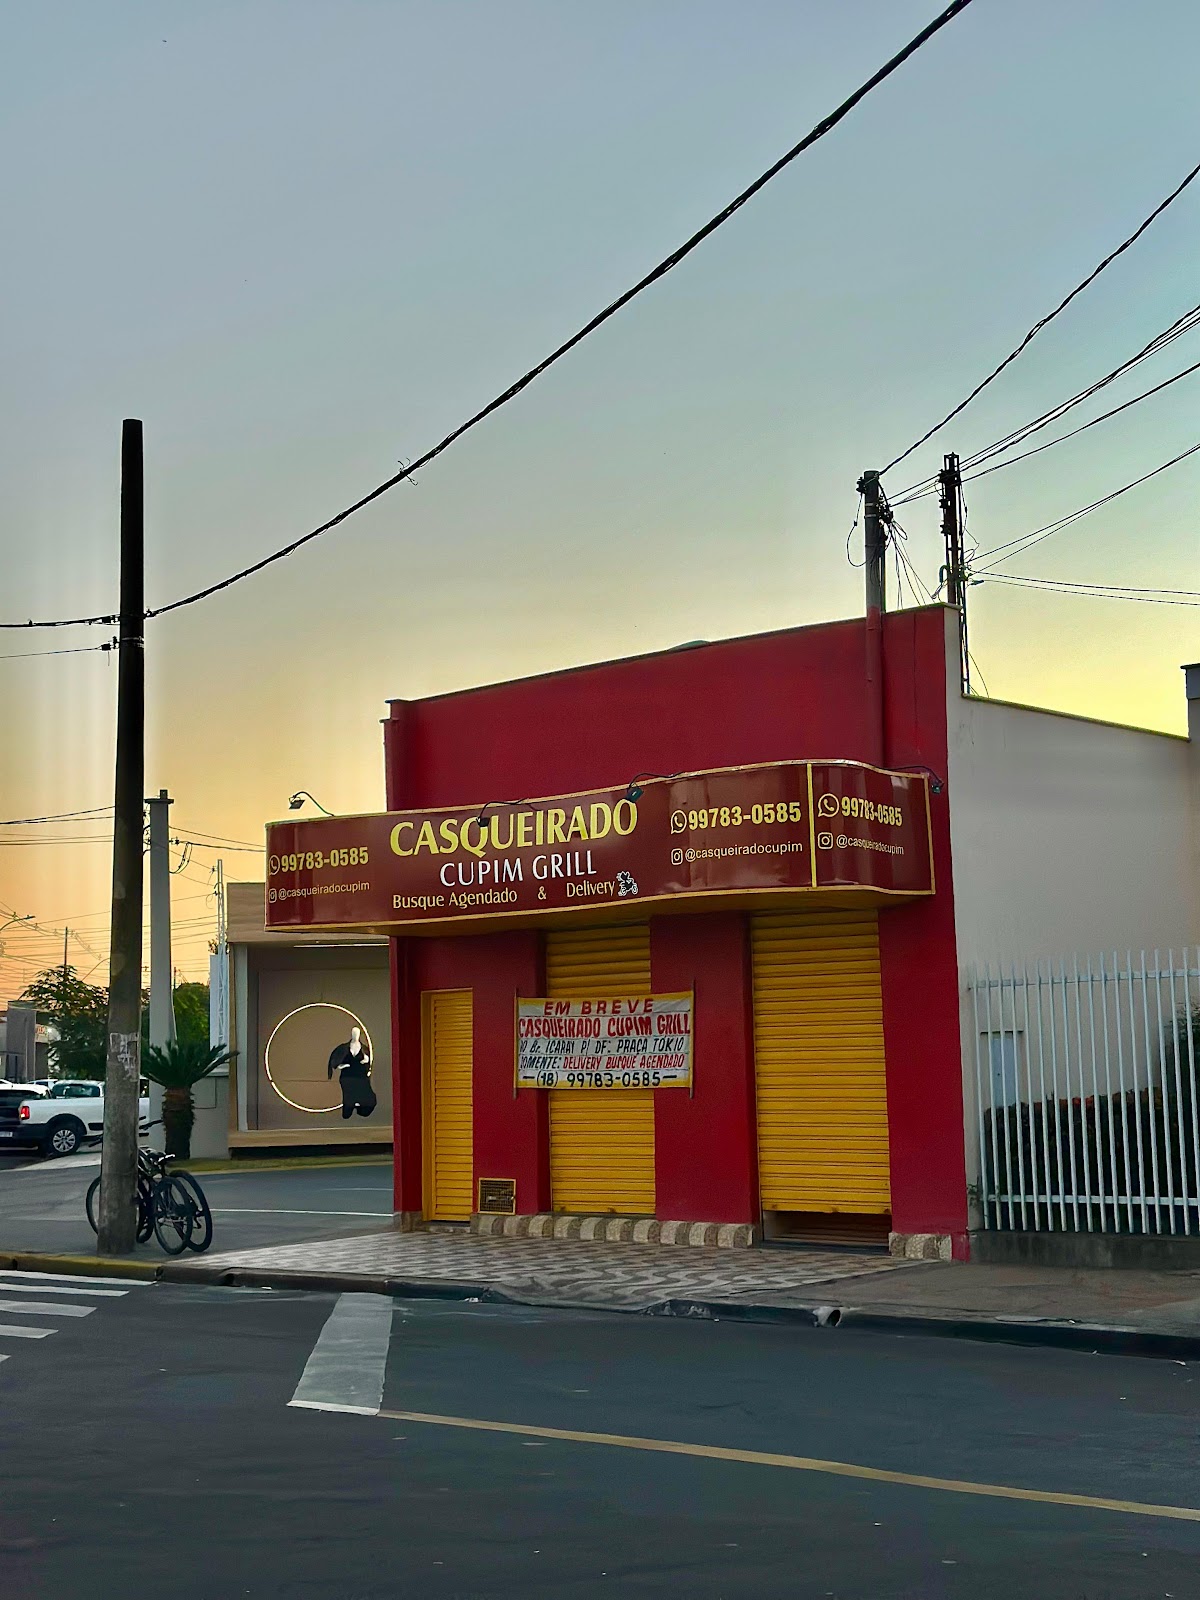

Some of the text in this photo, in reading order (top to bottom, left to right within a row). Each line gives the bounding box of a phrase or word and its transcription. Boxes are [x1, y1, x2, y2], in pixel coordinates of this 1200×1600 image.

[688, 802, 801, 830] 99783-0585
[841, 796, 903, 827] 99783-0585
[390, 798, 638, 858] CASQUEIRADO
[281, 847, 369, 872] 99783-0585
[685, 841, 803, 862] @casqueiradocupim
[440, 850, 597, 887] CUPIM GRILL
[278, 881, 370, 900] @casqueiradocupim
[393, 880, 615, 910] Busque Agendado & Delivery
[544, 998, 654, 1016] EM BREVE
[518, 1013, 690, 1039] CASQUEIRADO CUPIM GRILL
[617, 1038, 648, 1055] PRAÇA
[562, 1056, 602, 1071] DELIVERY
[640, 1053, 685, 1069] AGENDADO
